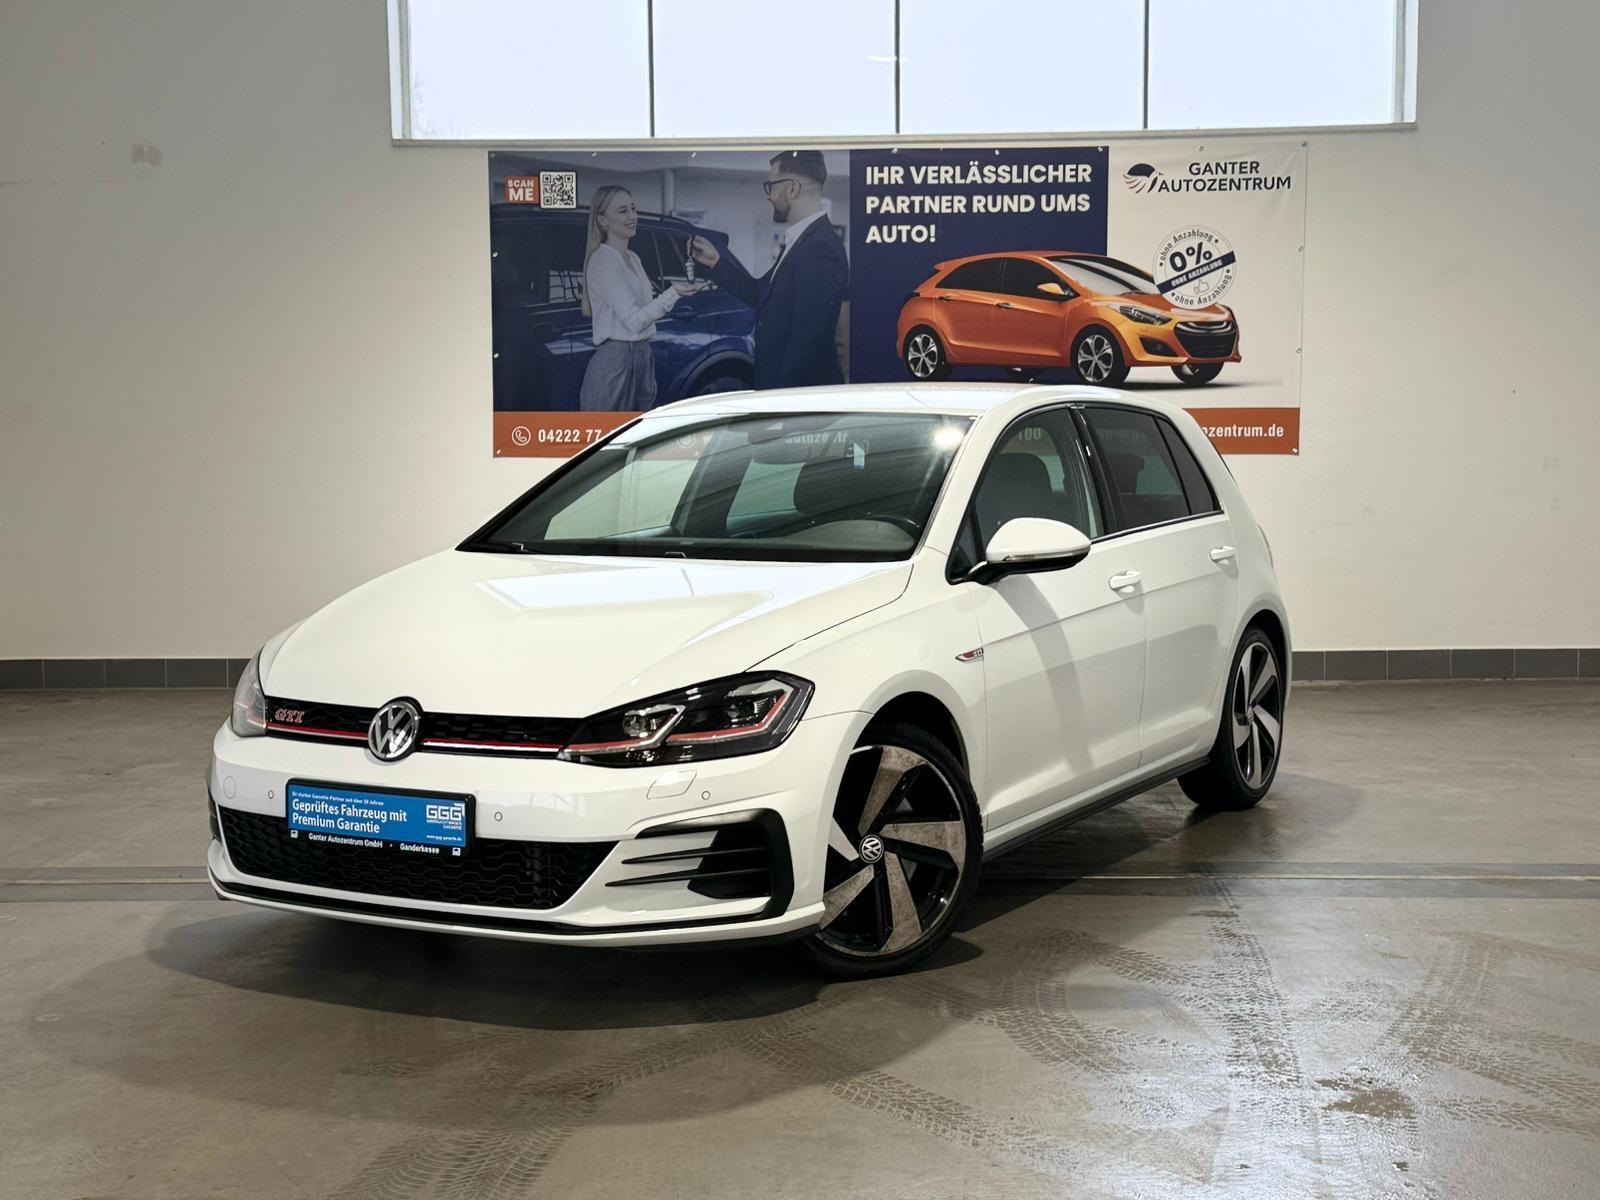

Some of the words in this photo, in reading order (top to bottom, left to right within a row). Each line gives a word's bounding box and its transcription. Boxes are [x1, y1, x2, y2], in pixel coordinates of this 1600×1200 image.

[866, 166, 904, 185] IHR
[910, 160, 1092, 184] VERLÄSSLICHER
[1189, 161, 1260, 176] GANTER
[507, 180, 534, 188] SCAN
[1158, 176, 1291, 193] AUTOZENTRUM
[508, 188, 534, 201] ME
[866, 196, 967, 214] PARTNER
[972, 196, 1035, 213] RUND
[1041, 194, 1091, 212] UMS
[866, 224, 936, 243] AUTO!
[1160, 243, 1173, 260] ohne
[1172, 229, 1214, 244] Anzahlung
[1169, 242, 1213, 272] 0%
[1175, 295, 1195, 305] ohne
[1197, 275, 1232, 305] Anzahlung
[538, 429, 580, 443] 04222
[274, 708, 305, 723] GTI
[292, 798, 339, 815] Geprüftes
[341, 804, 387, 822] Fahrzeug
[389, 809, 408, 822] mit
[426, 804, 462, 821] GGG
[292, 812, 335, 829] Premium
[336, 818, 380, 833] Garantie
[308, 832, 327, 841] Ganter
[327, 835, 363, 846] Autozentrum
[364, 839, 383, 849] GmbH
[399, 842, 440, 854] Ganderkesee
